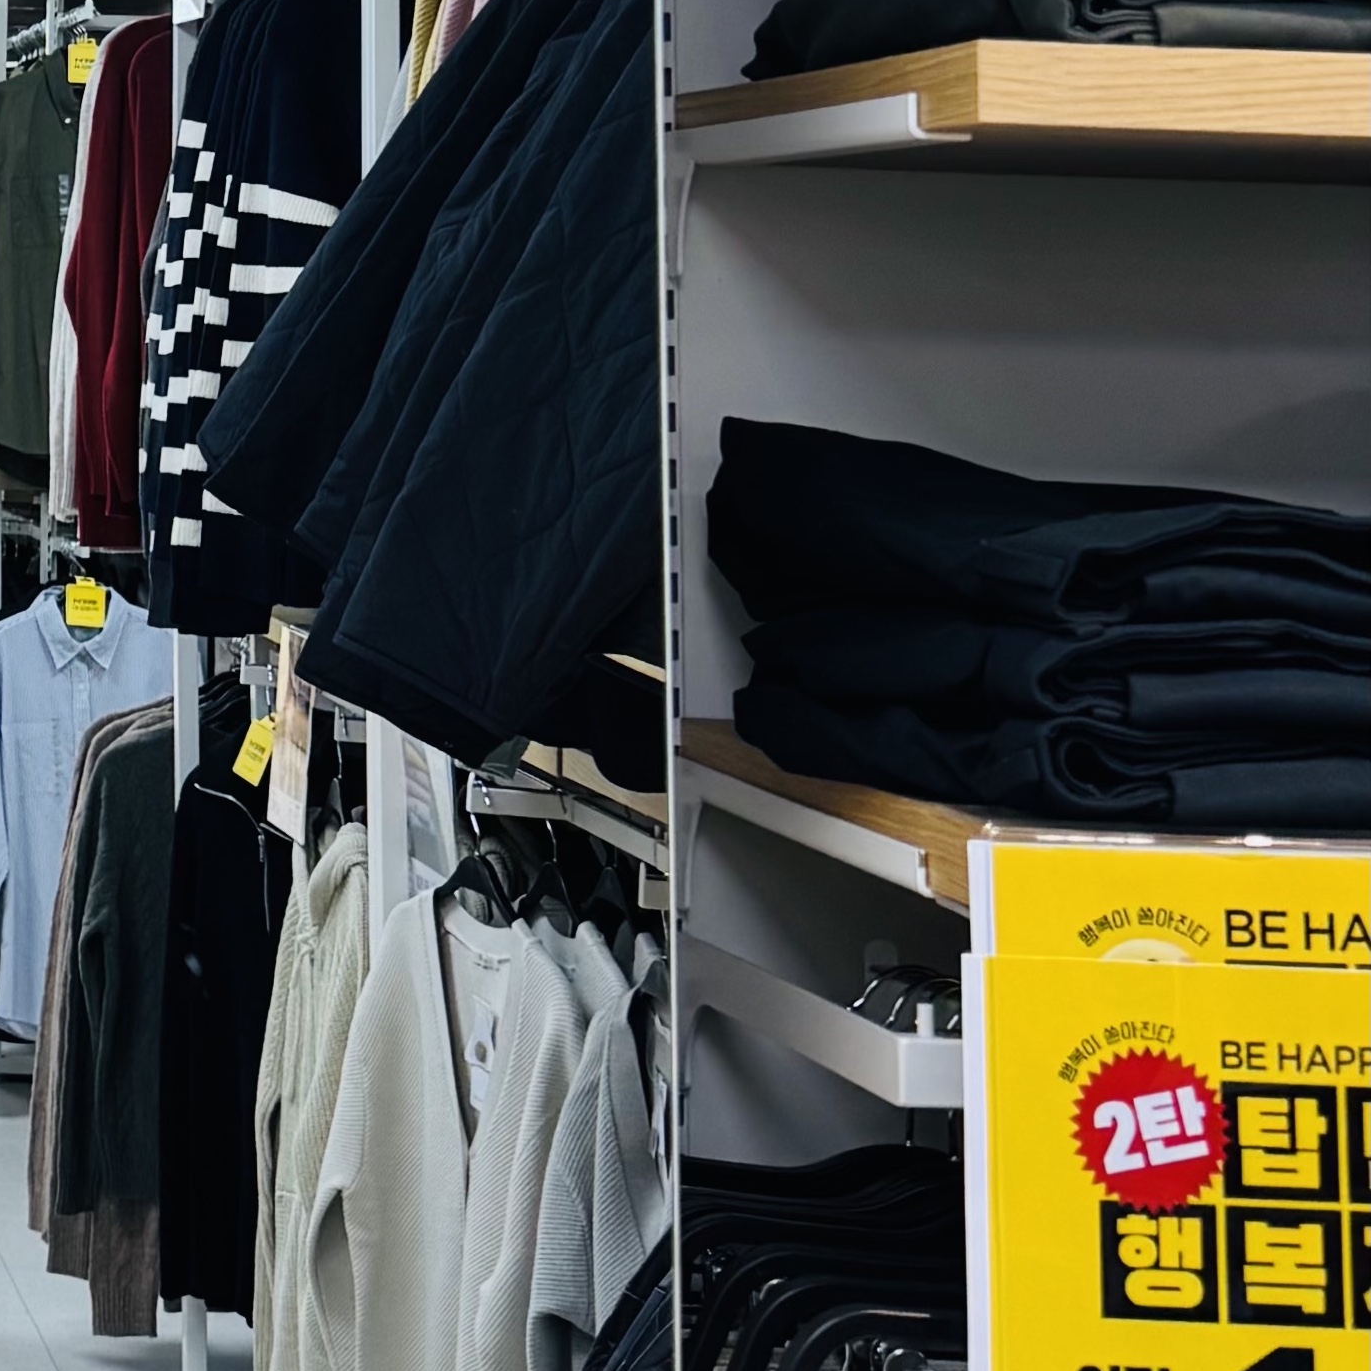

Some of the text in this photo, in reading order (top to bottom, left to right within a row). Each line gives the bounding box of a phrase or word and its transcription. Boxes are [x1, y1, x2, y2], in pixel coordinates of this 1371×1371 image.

[1077, 907, 1131, 947] 행복이
[1224, 909, 1289, 949] BE
[1058, 1034, 1102, 1084] 행복이
[1220, 1040, 1268, 1071] BE
[1093, 1085, 1210, 1175] 2탄
